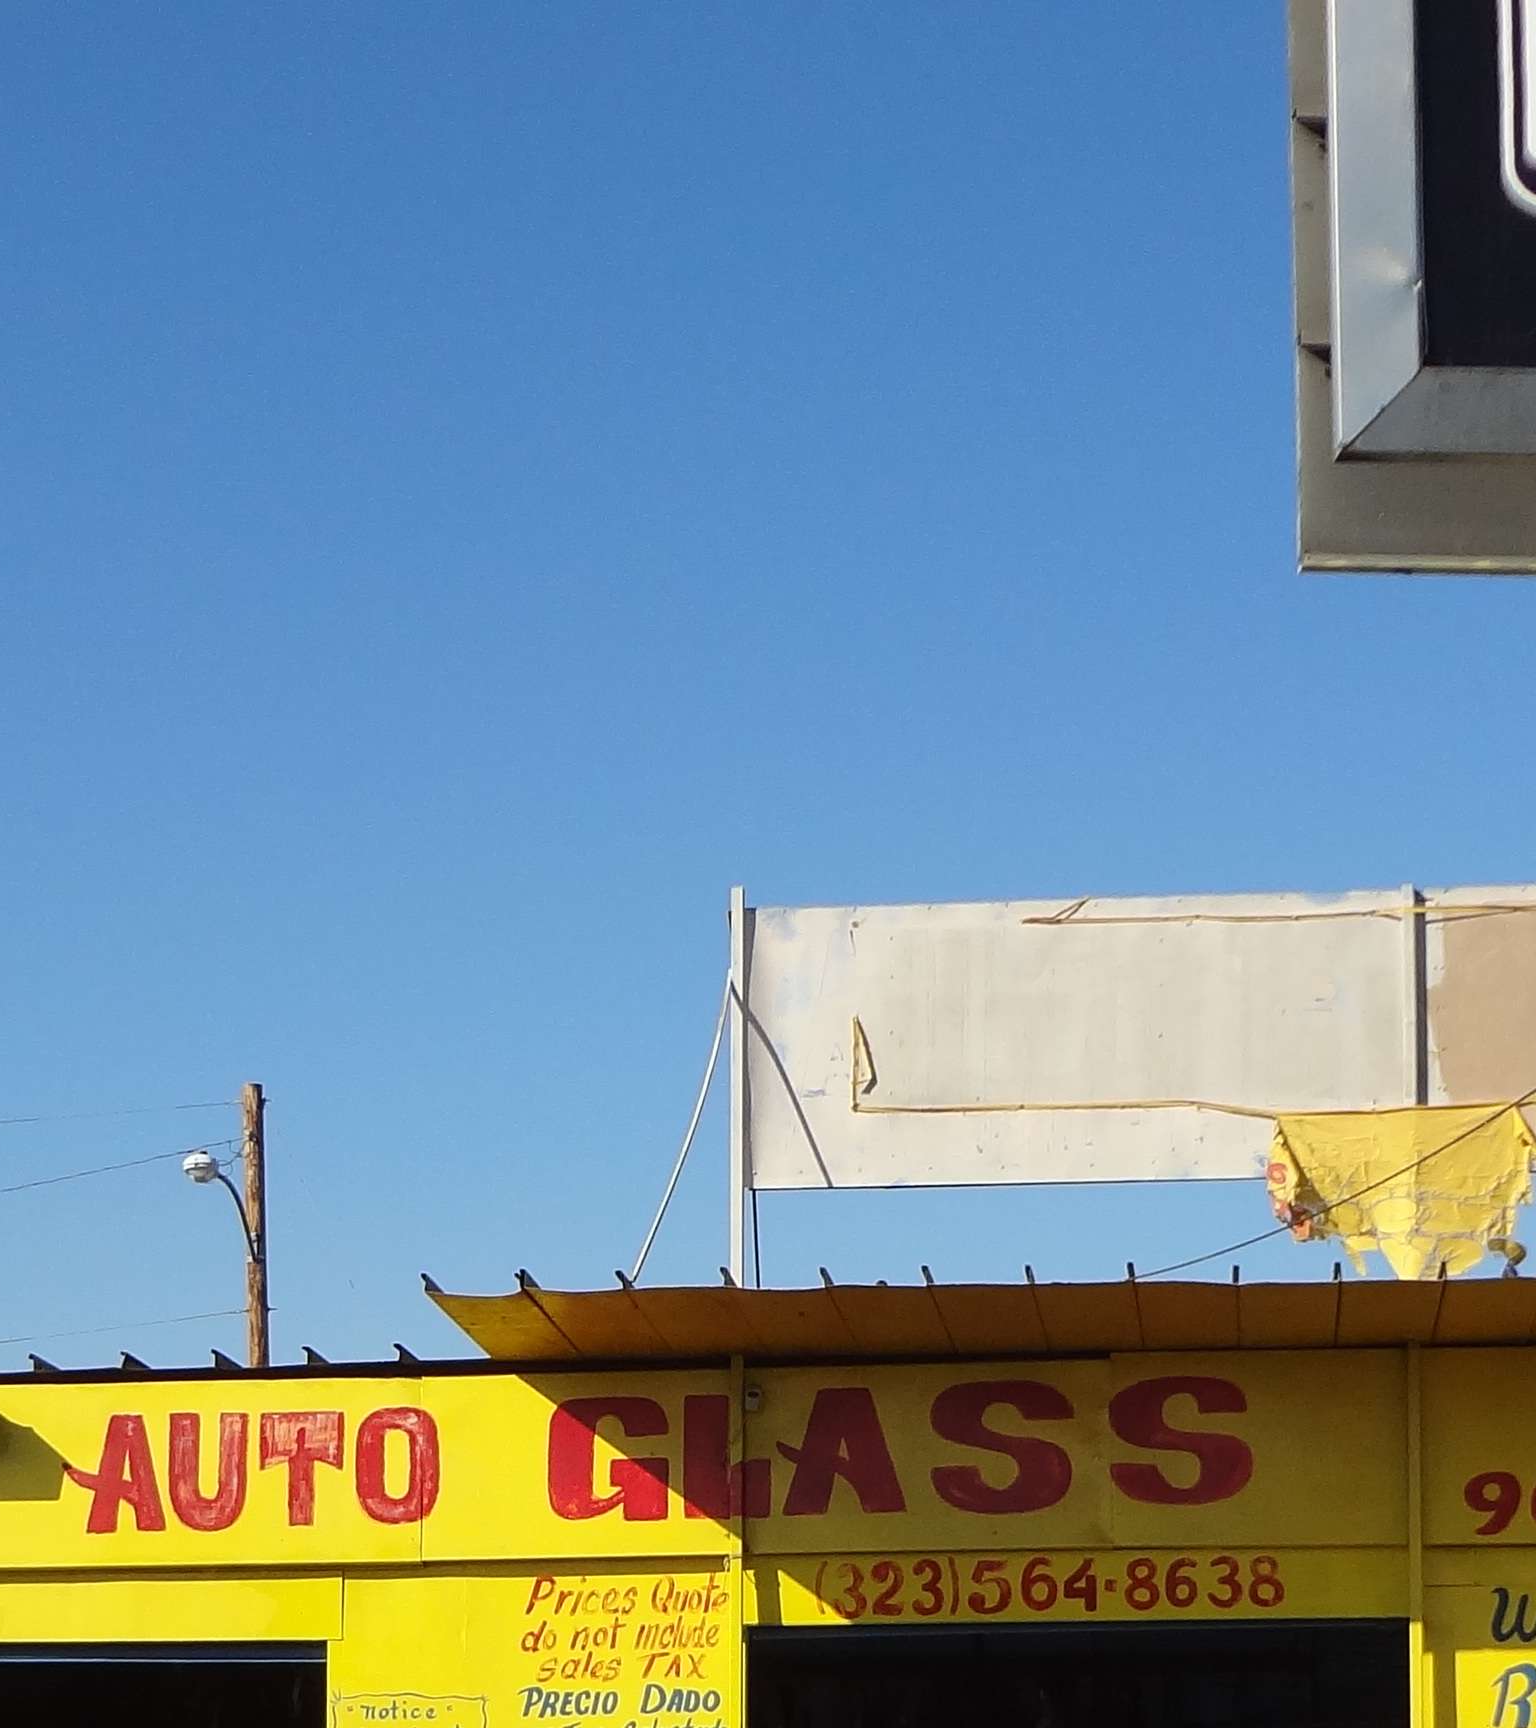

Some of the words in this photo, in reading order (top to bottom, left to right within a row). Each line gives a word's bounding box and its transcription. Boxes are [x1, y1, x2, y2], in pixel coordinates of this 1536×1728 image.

[64, 1407, 440, 1534] AUTO
[548, 1375, 1254, 1521] GLASS
[525, 1573, 638, 1616] Prices
[521, 1619, 557, 1652] do
[569, 1616, 626, 1650] not
[639, 1652, 708, 1680] TAX
[518, 1685, 619, 1718] PRECIO
[640, 1683, 721, 1714] DADO
